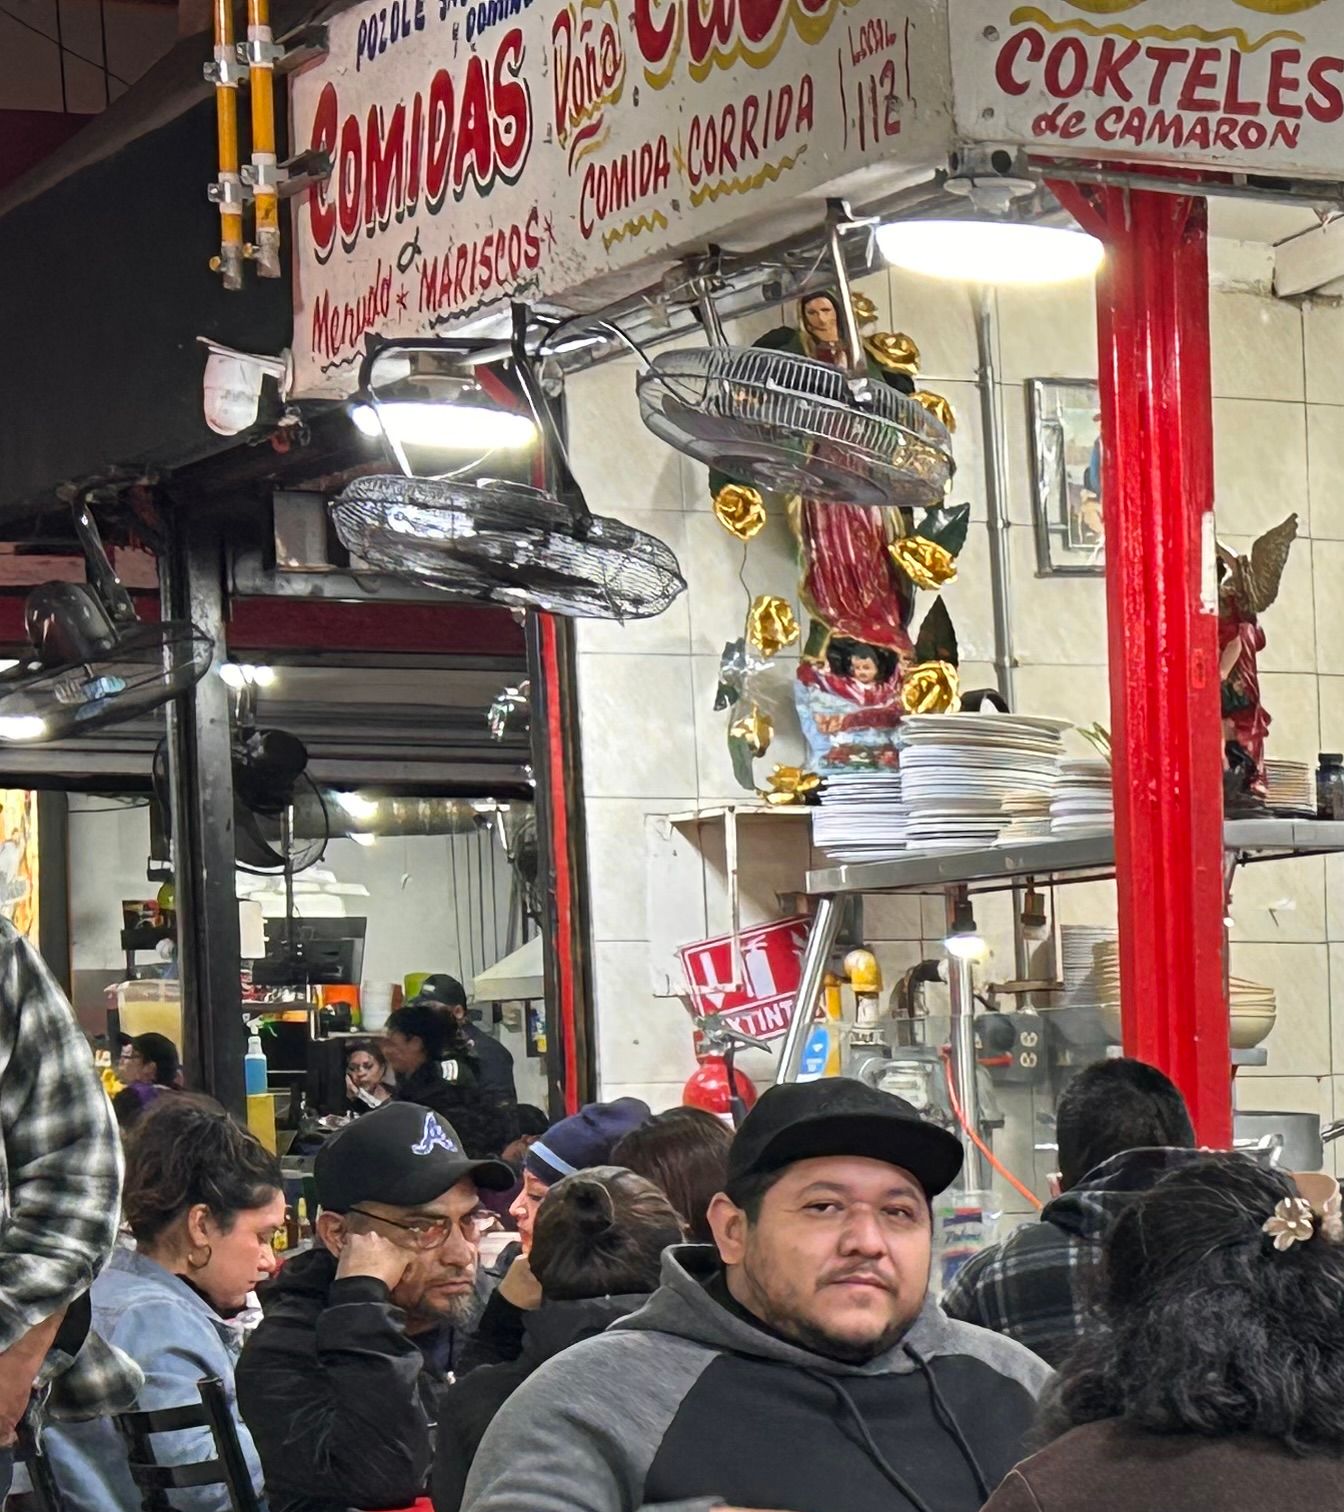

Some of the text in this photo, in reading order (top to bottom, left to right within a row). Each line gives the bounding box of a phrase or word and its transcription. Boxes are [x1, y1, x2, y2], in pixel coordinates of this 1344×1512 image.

[551, 8, 621, 142] Doña
[848, 18, 897, 66] LOCAL
[995, 27, 1344, 123] COKTELES
[309, 28, 532, 252] COMIDAS
[580, 73, 814, 240] COMIDA CORRIDA
[857, 60, 902, 152] 112
[1031, 102, 1301, 150] de CAMARON
[312, 205, 541, 359] Menudo MARISCOS
